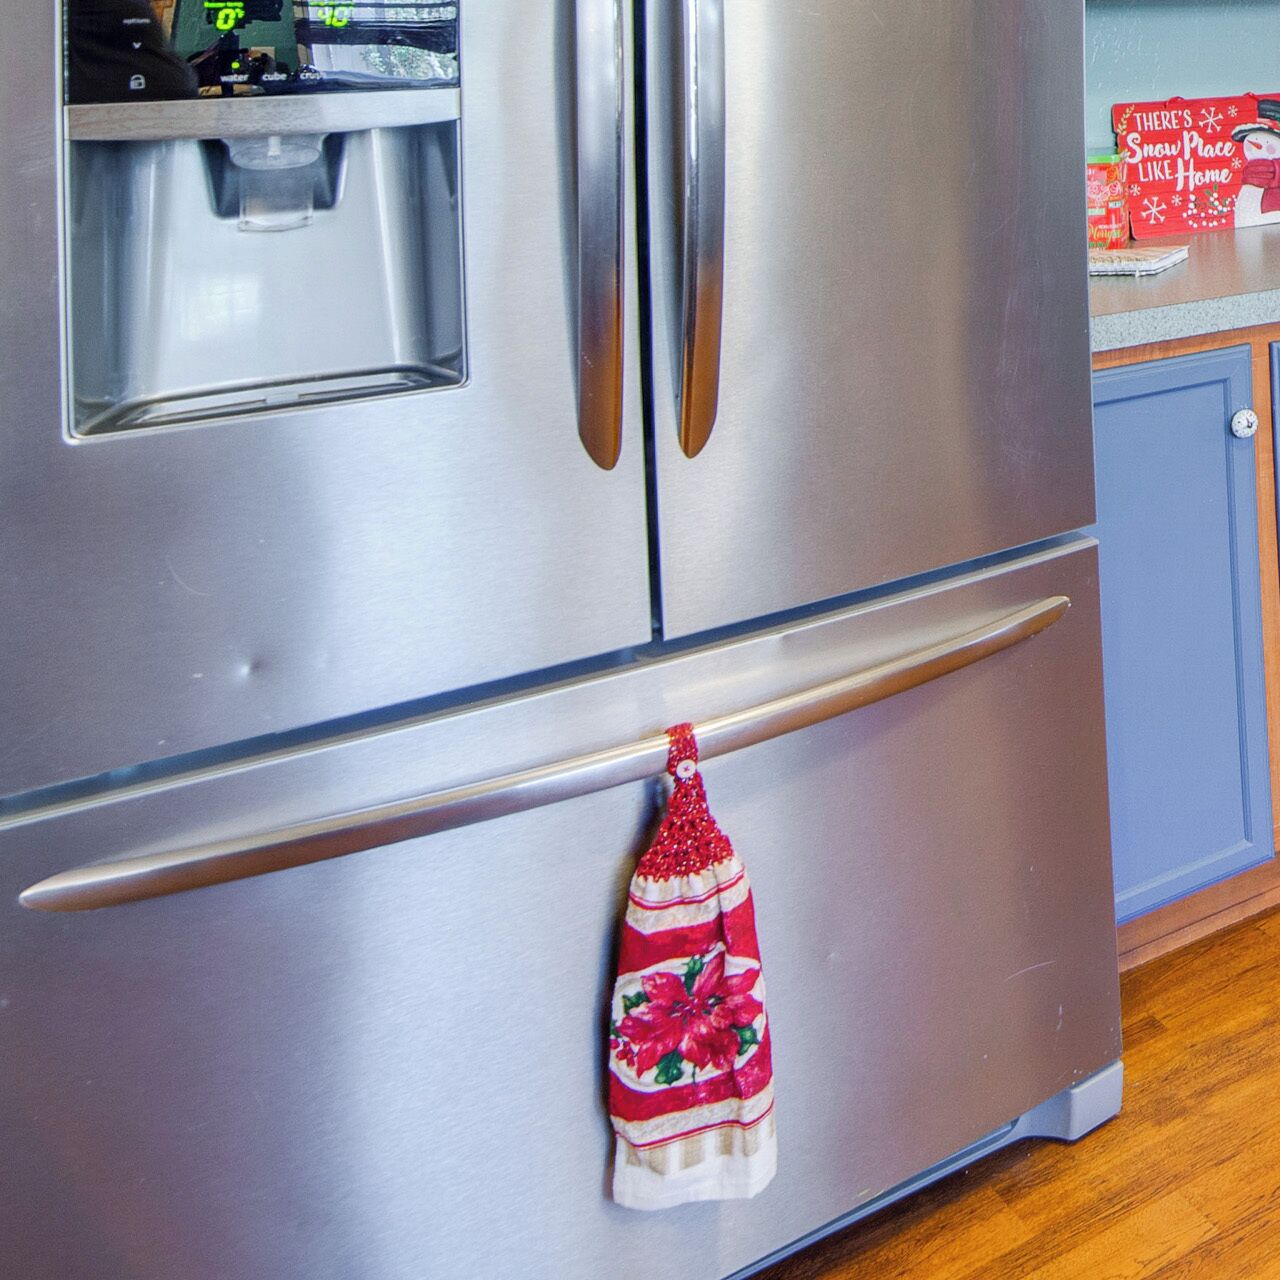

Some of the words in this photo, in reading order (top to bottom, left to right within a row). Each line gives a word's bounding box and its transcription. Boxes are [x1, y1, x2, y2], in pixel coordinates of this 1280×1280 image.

[220, 73, 249, 83] water
[262, 71, 288, 81] cube
[1133, 109, 1193, 131] THERE'S
[1125, 132, 1181, 164] Snow
[1182, 130, 1237, 160] Place
[1138, 160, 1174, 182] LIKE
[1175, 157, 1233, 192] Home
